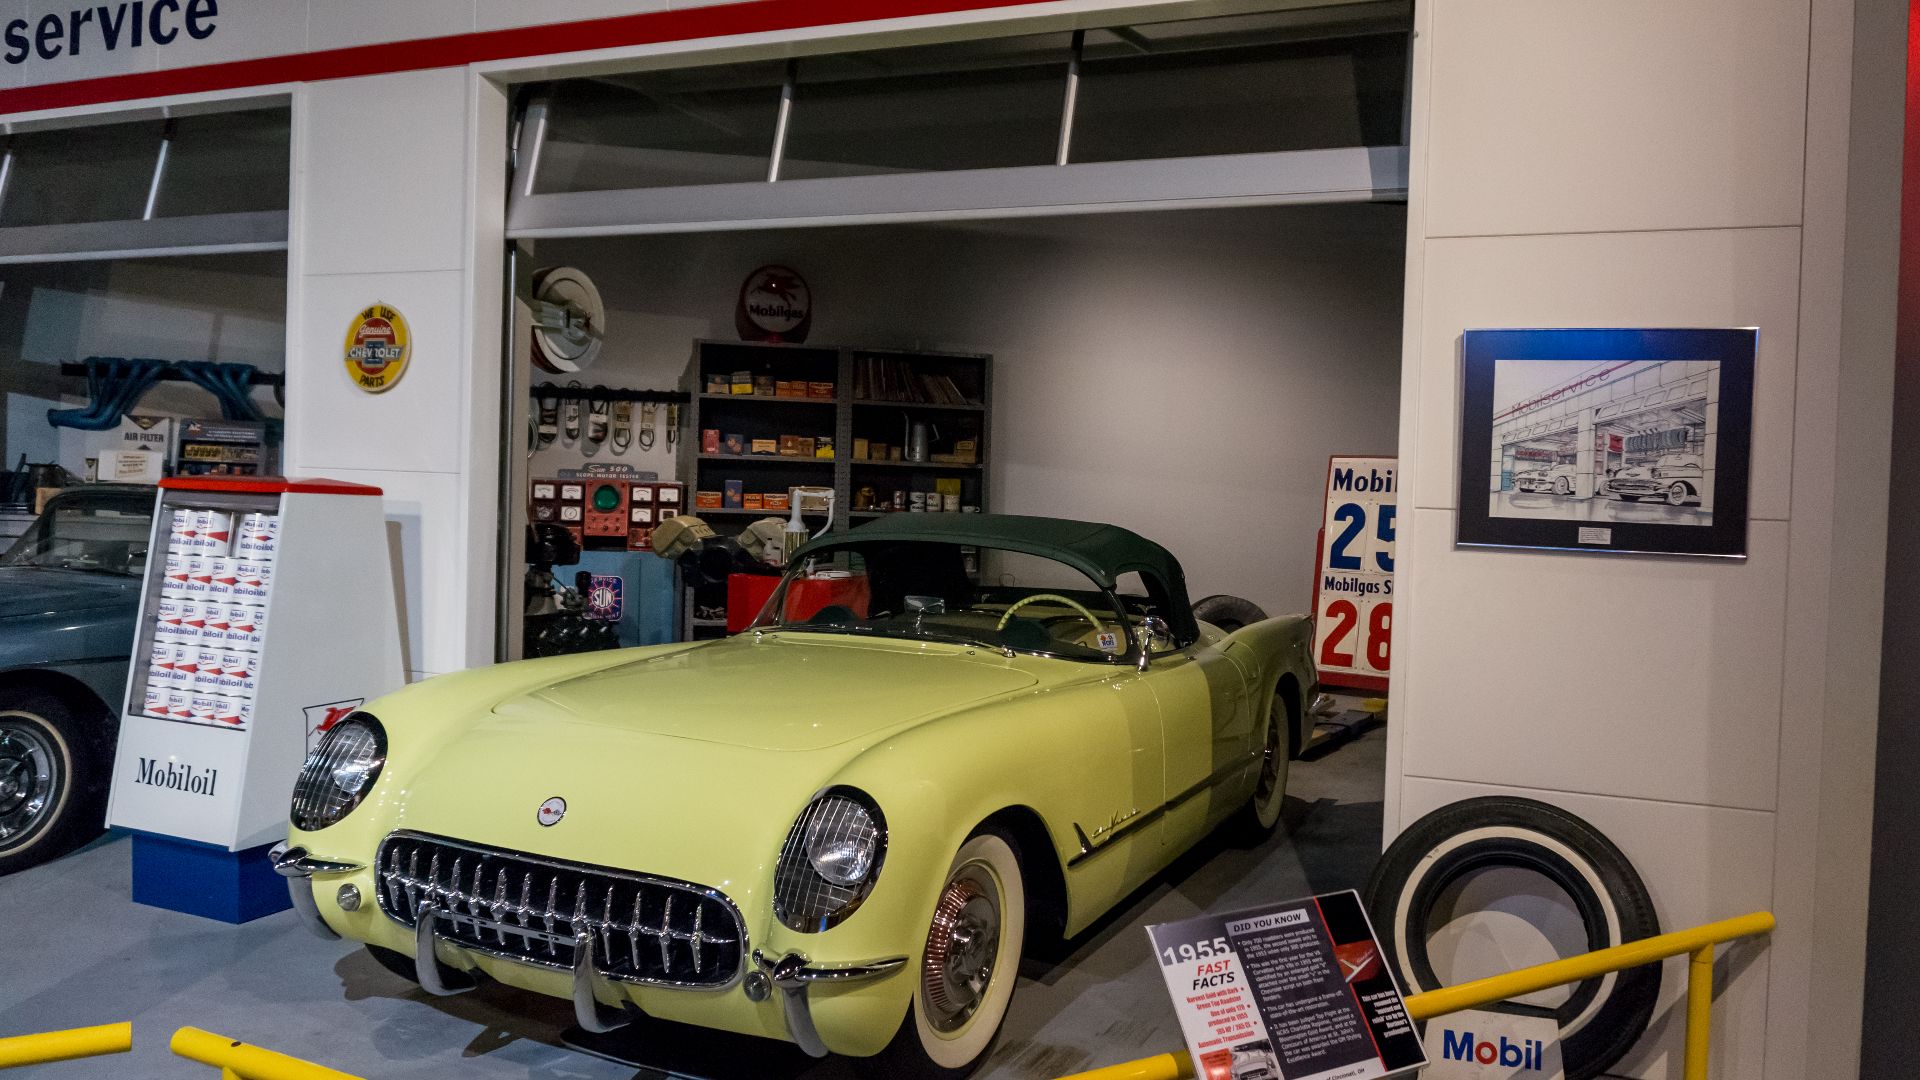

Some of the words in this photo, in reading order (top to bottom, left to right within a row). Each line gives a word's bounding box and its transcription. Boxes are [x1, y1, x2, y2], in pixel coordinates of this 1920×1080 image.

[4, 0, 218, 64] service
[361, 307, 375, 319] WE
[380, 306, 396, 322] USE
[749, 304, 804, 322] Mobilgas
[358, 324, 392, 338] Genuine
[359, 375, 385, 388] PARTS
[1511, 368, 1610, 417] Mobilservice
[124, 432, 138, 442] AIR
[139, 432, 164, 443] FILTER
[1325, 576, 1380, 596] Mobilgas
[1383, 579, 1393, 596] S
[593, 588, 613, 608] SUN
[1320, 600, 1393, 671] 28
[135, 757, 217, 797] Mobiloil
[1234, 922, 1251, 932] DID
[1254, 918, 1272, 928] YOU
[1275, 913, 1301, 925] KNOW
[1164, 937, 1230, 965] 1955
[1197, 960, 1231, 977] FAST
[1193, 972, 1235, 990] FACTS
[1443, 1029, 1542, 1071] Mobil
